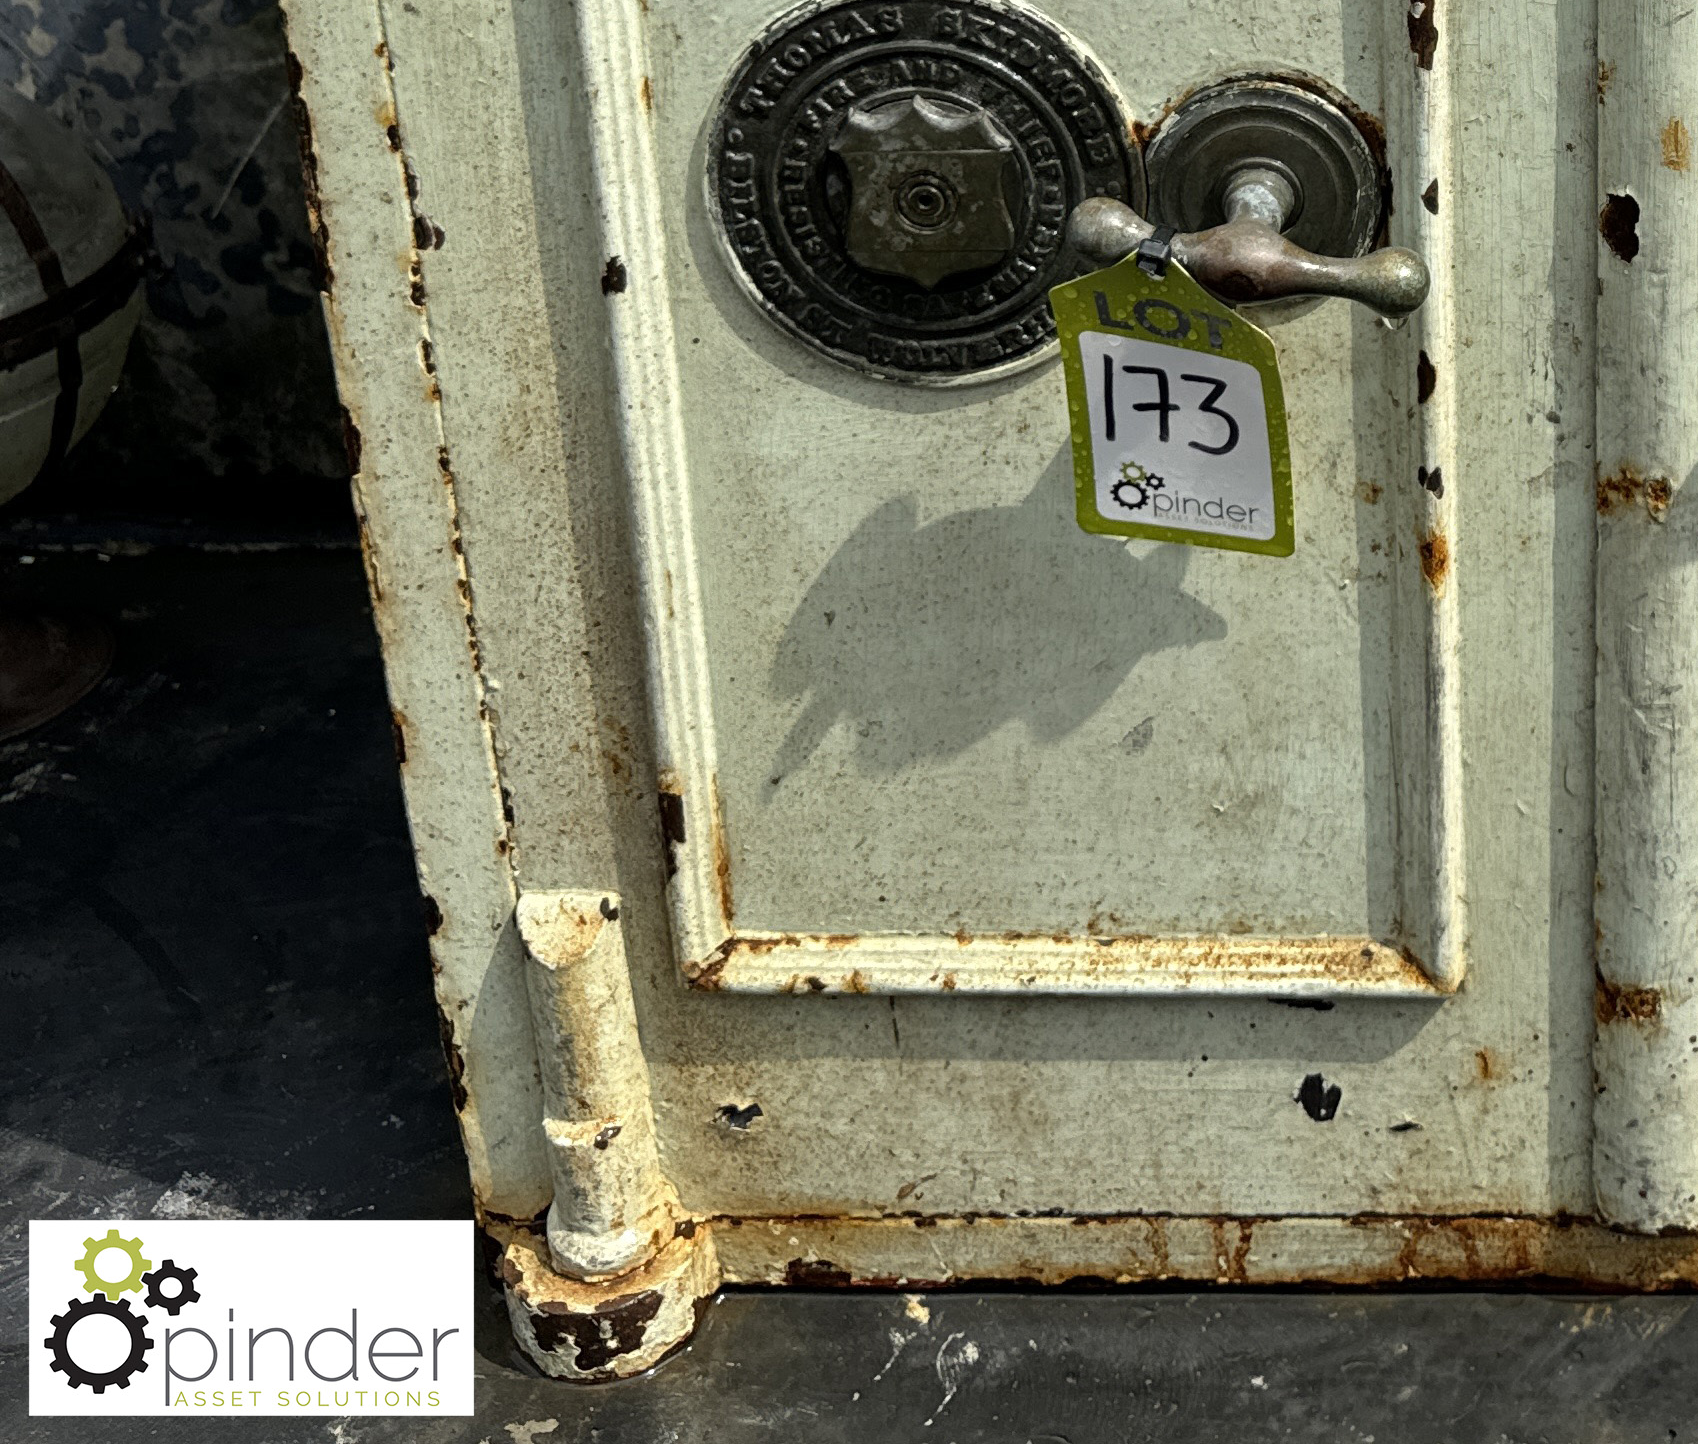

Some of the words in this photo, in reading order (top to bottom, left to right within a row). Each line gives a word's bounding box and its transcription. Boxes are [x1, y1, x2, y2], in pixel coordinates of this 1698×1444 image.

[740, 6, 903, 119] THOMAS
[934, 9, 1117, 168] SKIDMORE
[800, 64, 876, 133] FIRE
[885, 59, 962, 87] AND
[1093, 291, 1232, 349] LOT
[1103, 354, 1239, 455] 173
[1153, 490, 1259, 523] pinder
